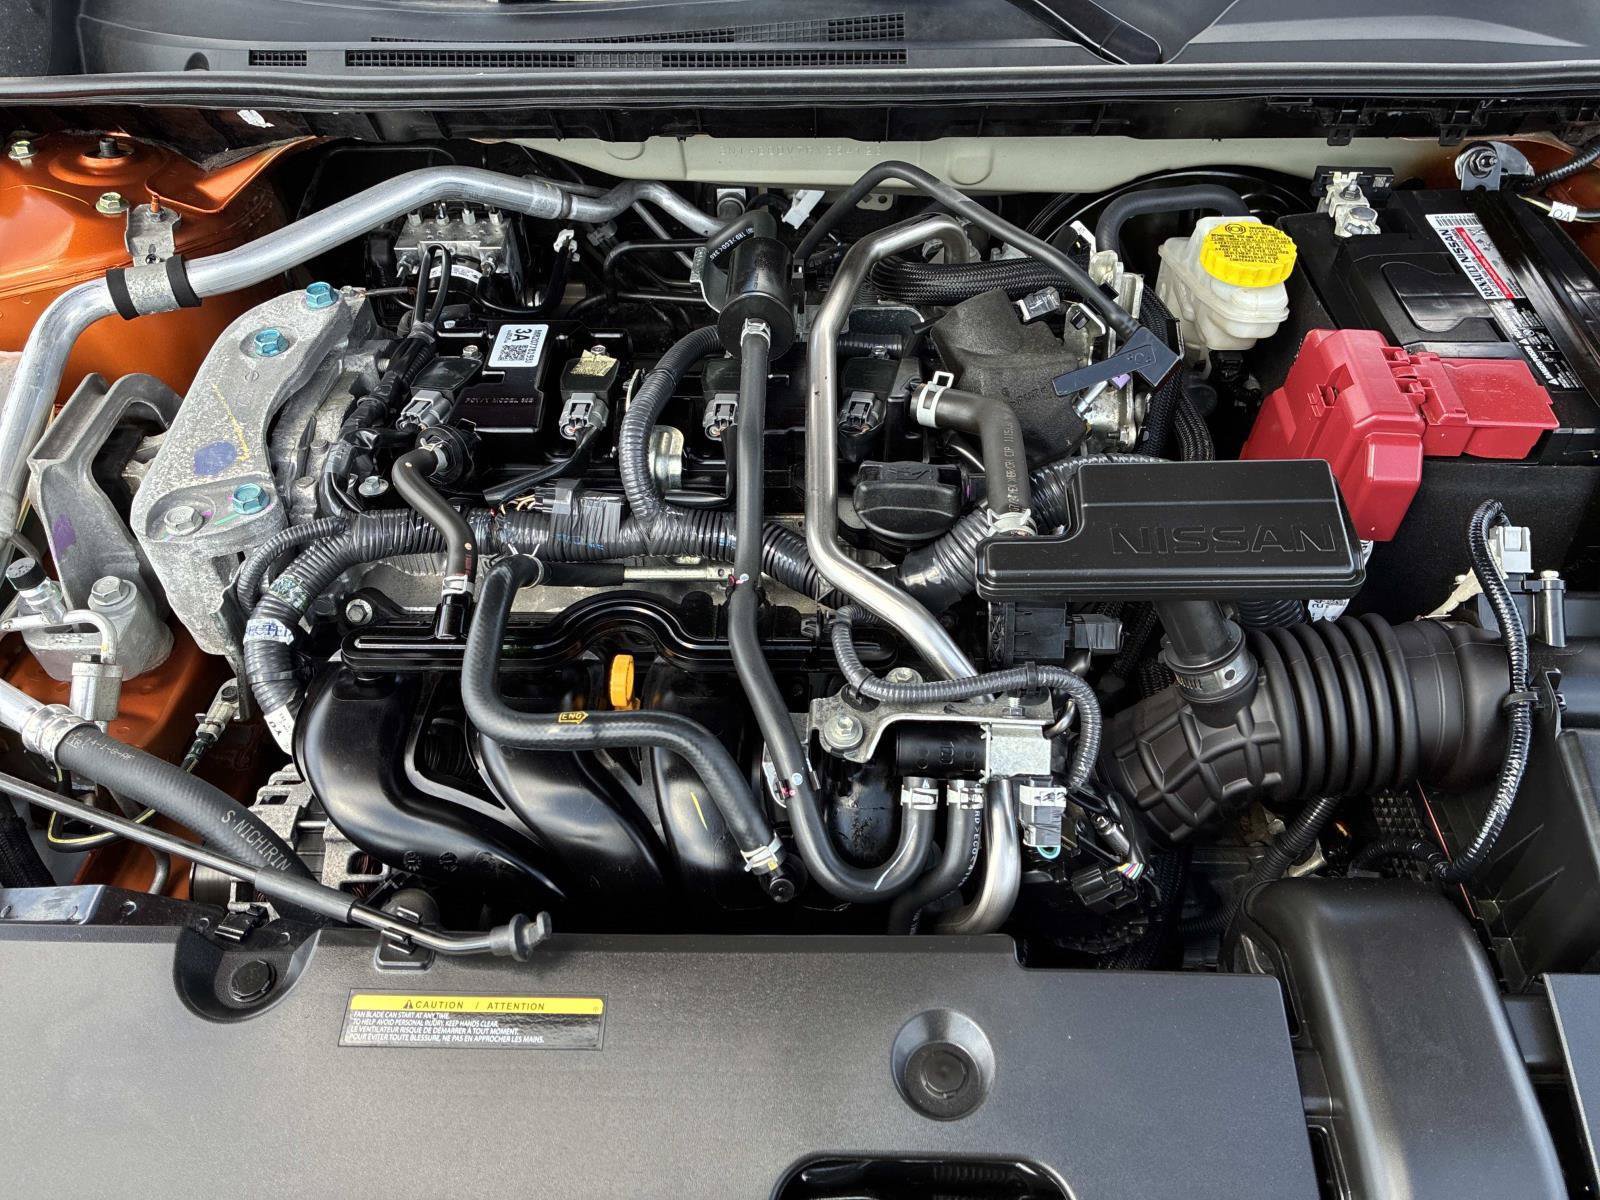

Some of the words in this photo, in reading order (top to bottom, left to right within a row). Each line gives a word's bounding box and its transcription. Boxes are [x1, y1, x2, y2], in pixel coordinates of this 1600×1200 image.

[1439, 229, 1470, 263] NISSAN
[1465, 263, 1497, 298] RENAULT
[512, 328, 532, 342] 3A
[1109, 524, 1337, 555] NISSAN
[416, 1000, 464, 1009] CAUTION
[487, 1002, 545, 1011] ATTENTION
[352, 1018, 361, 1026] TO
[400, 1026, 422, 1034] RISQUE
